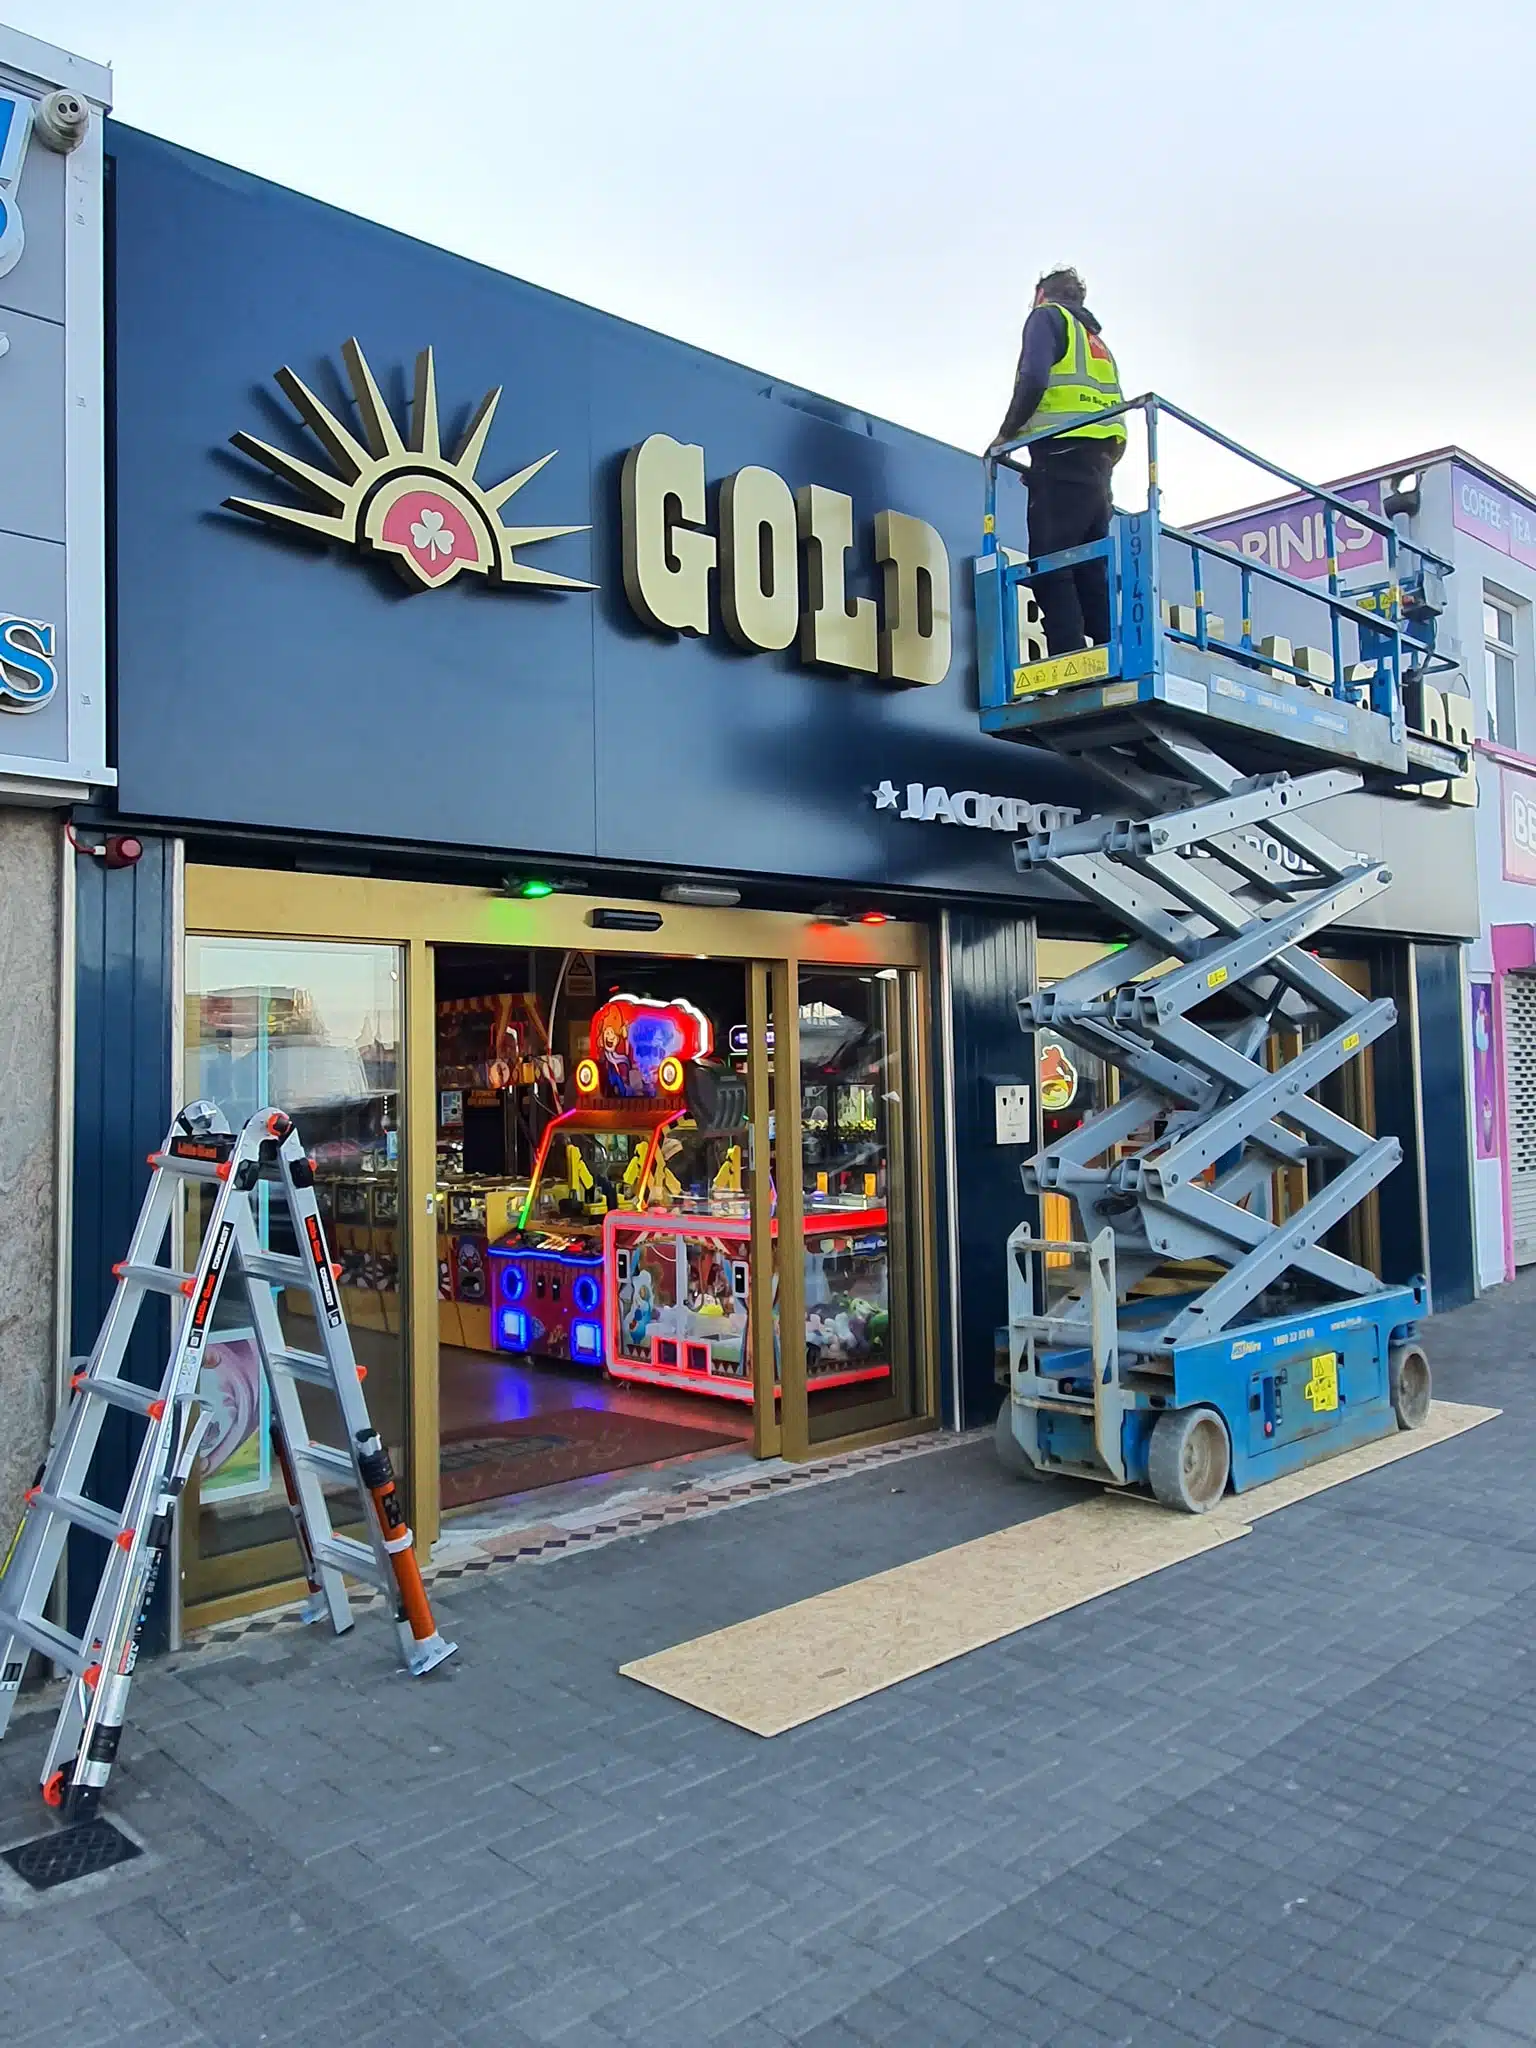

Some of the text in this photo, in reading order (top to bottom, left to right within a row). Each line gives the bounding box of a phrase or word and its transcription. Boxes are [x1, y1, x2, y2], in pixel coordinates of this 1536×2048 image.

[1214, 499, 1375, 569] RINKS
[1461, 484, 1502, 530] COFFEE
[1510, 510, 1531, 544] TEA
[621, 432, 953, 688] GOLD
[1129, 515, 1145, 647] 091401
[900, 782, 1082, 834] JACKPOT
[212, 1225, 230, 1270] CONQUEST
